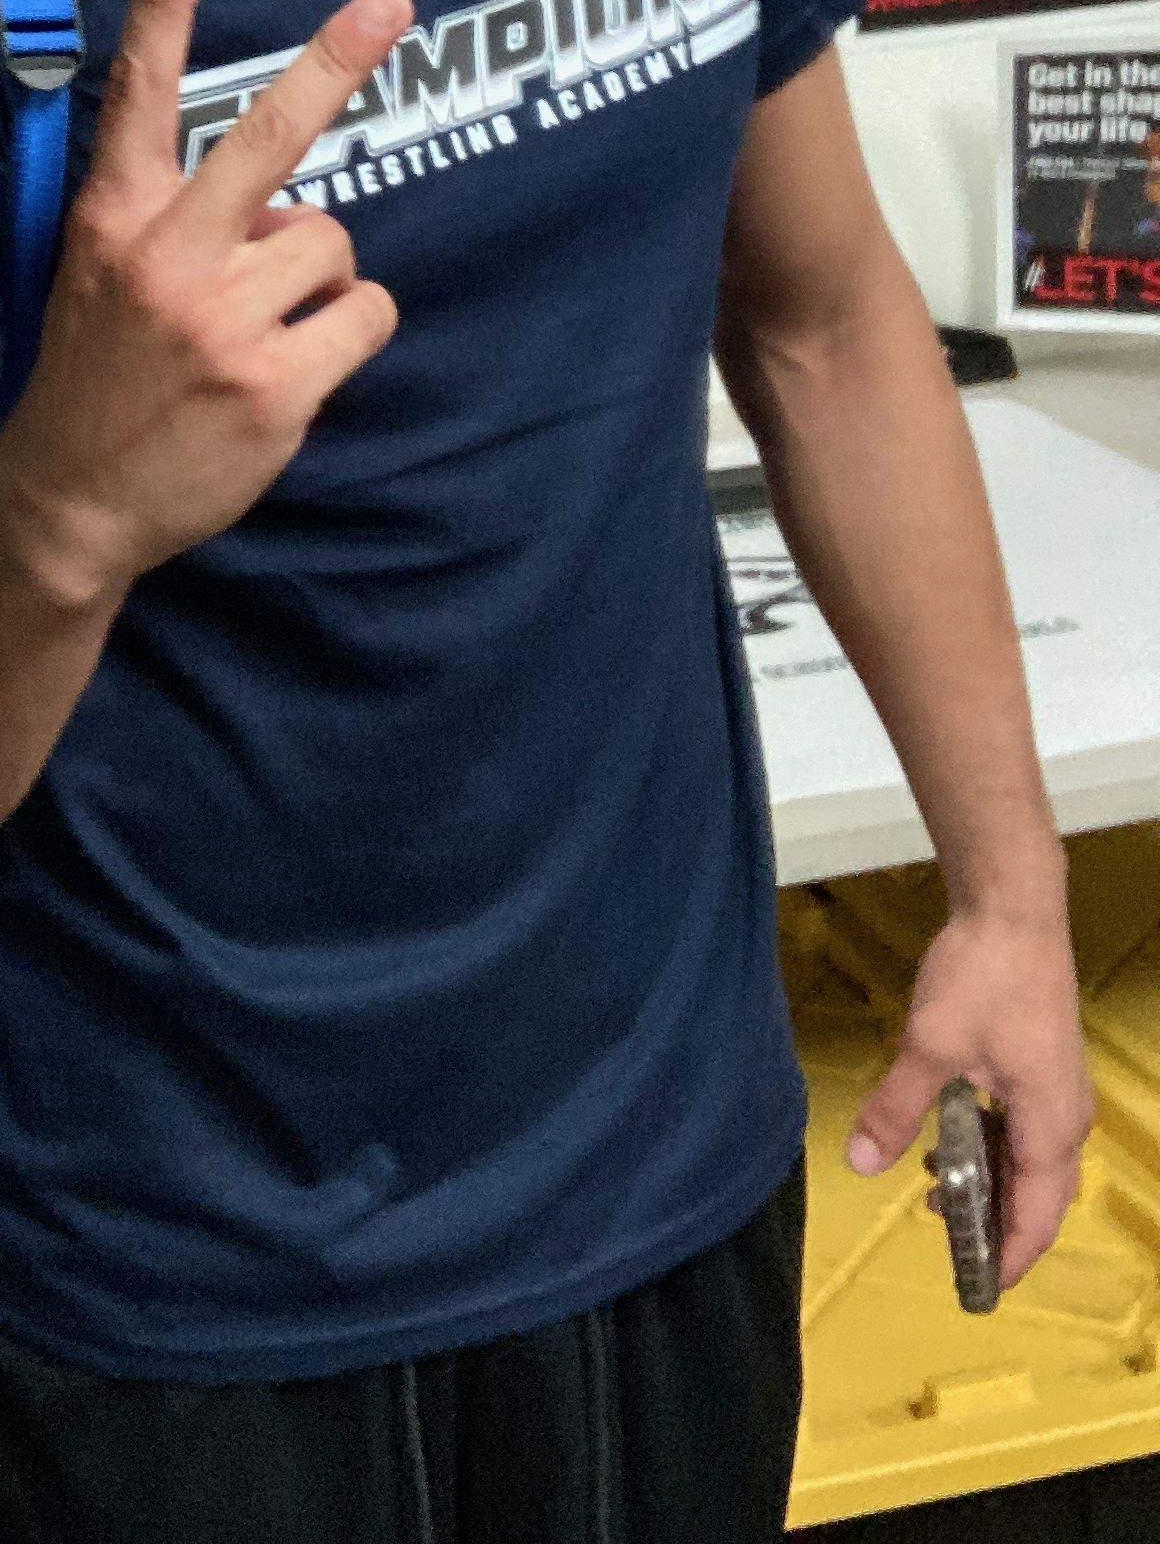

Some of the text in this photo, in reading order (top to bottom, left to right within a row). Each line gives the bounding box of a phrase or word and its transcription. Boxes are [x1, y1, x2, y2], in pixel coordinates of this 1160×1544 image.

[1027, 61, 1079, 88] Get
[1083, 58, 1113, 88] in
[1027, 87, 1092, 115] best
[295, 40, 693, 211] WRESTLING ACADEMY
[1026, 118, 1095, 149] your
